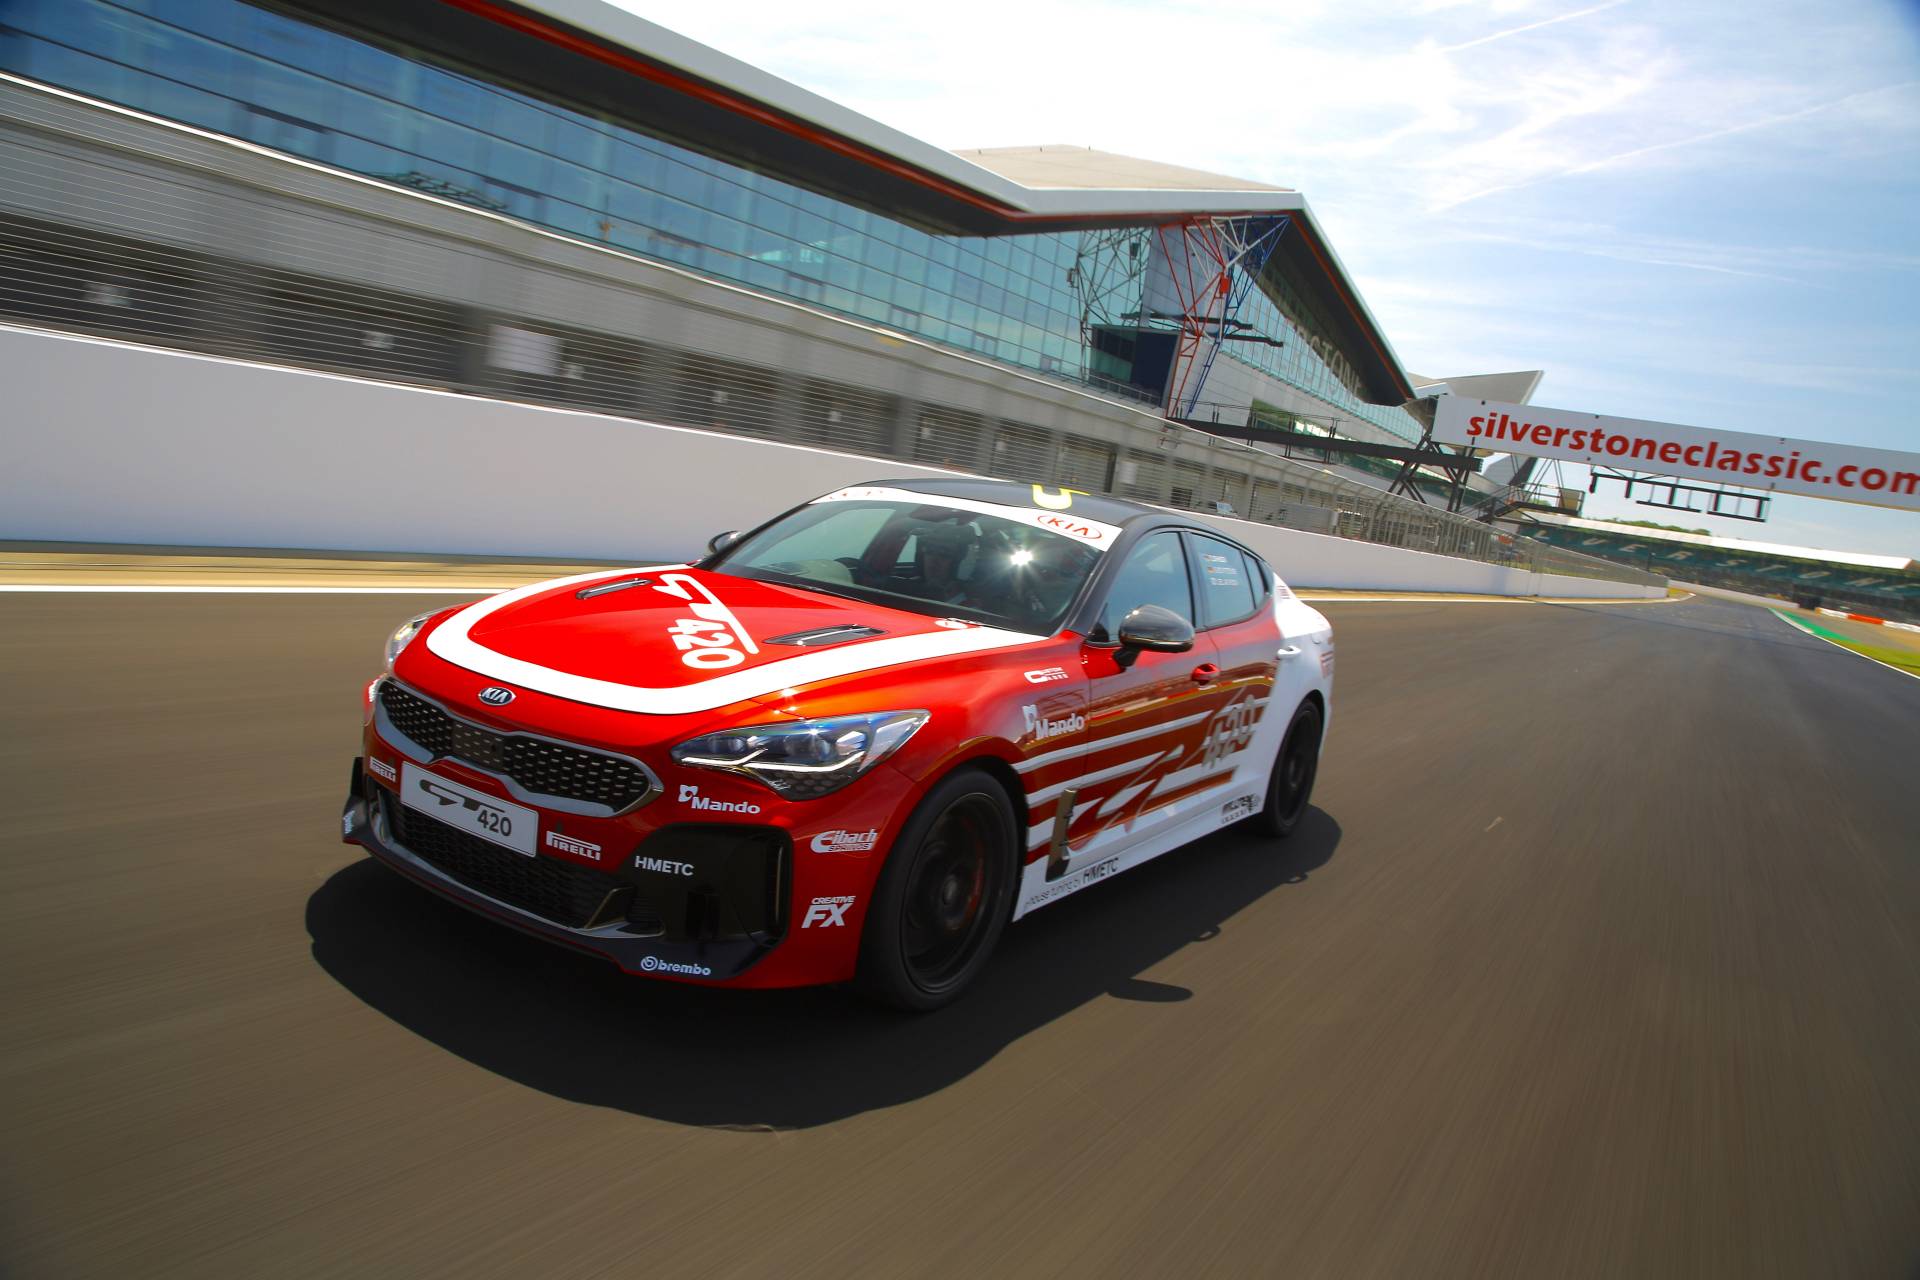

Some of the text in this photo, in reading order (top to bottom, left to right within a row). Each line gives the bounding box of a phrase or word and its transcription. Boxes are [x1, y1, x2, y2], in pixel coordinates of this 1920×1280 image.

[1466, 411, 1920, 496] silverstoneclassic.com
[1048, 517, 1089, 536] KIA
[667, 618, 746, 669] 420
[481, 687, 509, 703] KIA
[1036, 713, 1085, 740] Mando
[691, 796, 761, 815] Mando
[477, 809, 513, 837] 420
[546, 830, 602, 861] PIRELLI
[810, 828, 878, 854] Eibach
[634, 855, 695, 877] HMETC
[1083, 857, 1119, 884] HMETC
[811, 895, 857, 905] CREATIVE
[801, 903, 854, 929] FX
[658, 959, 712, 976] brembo
